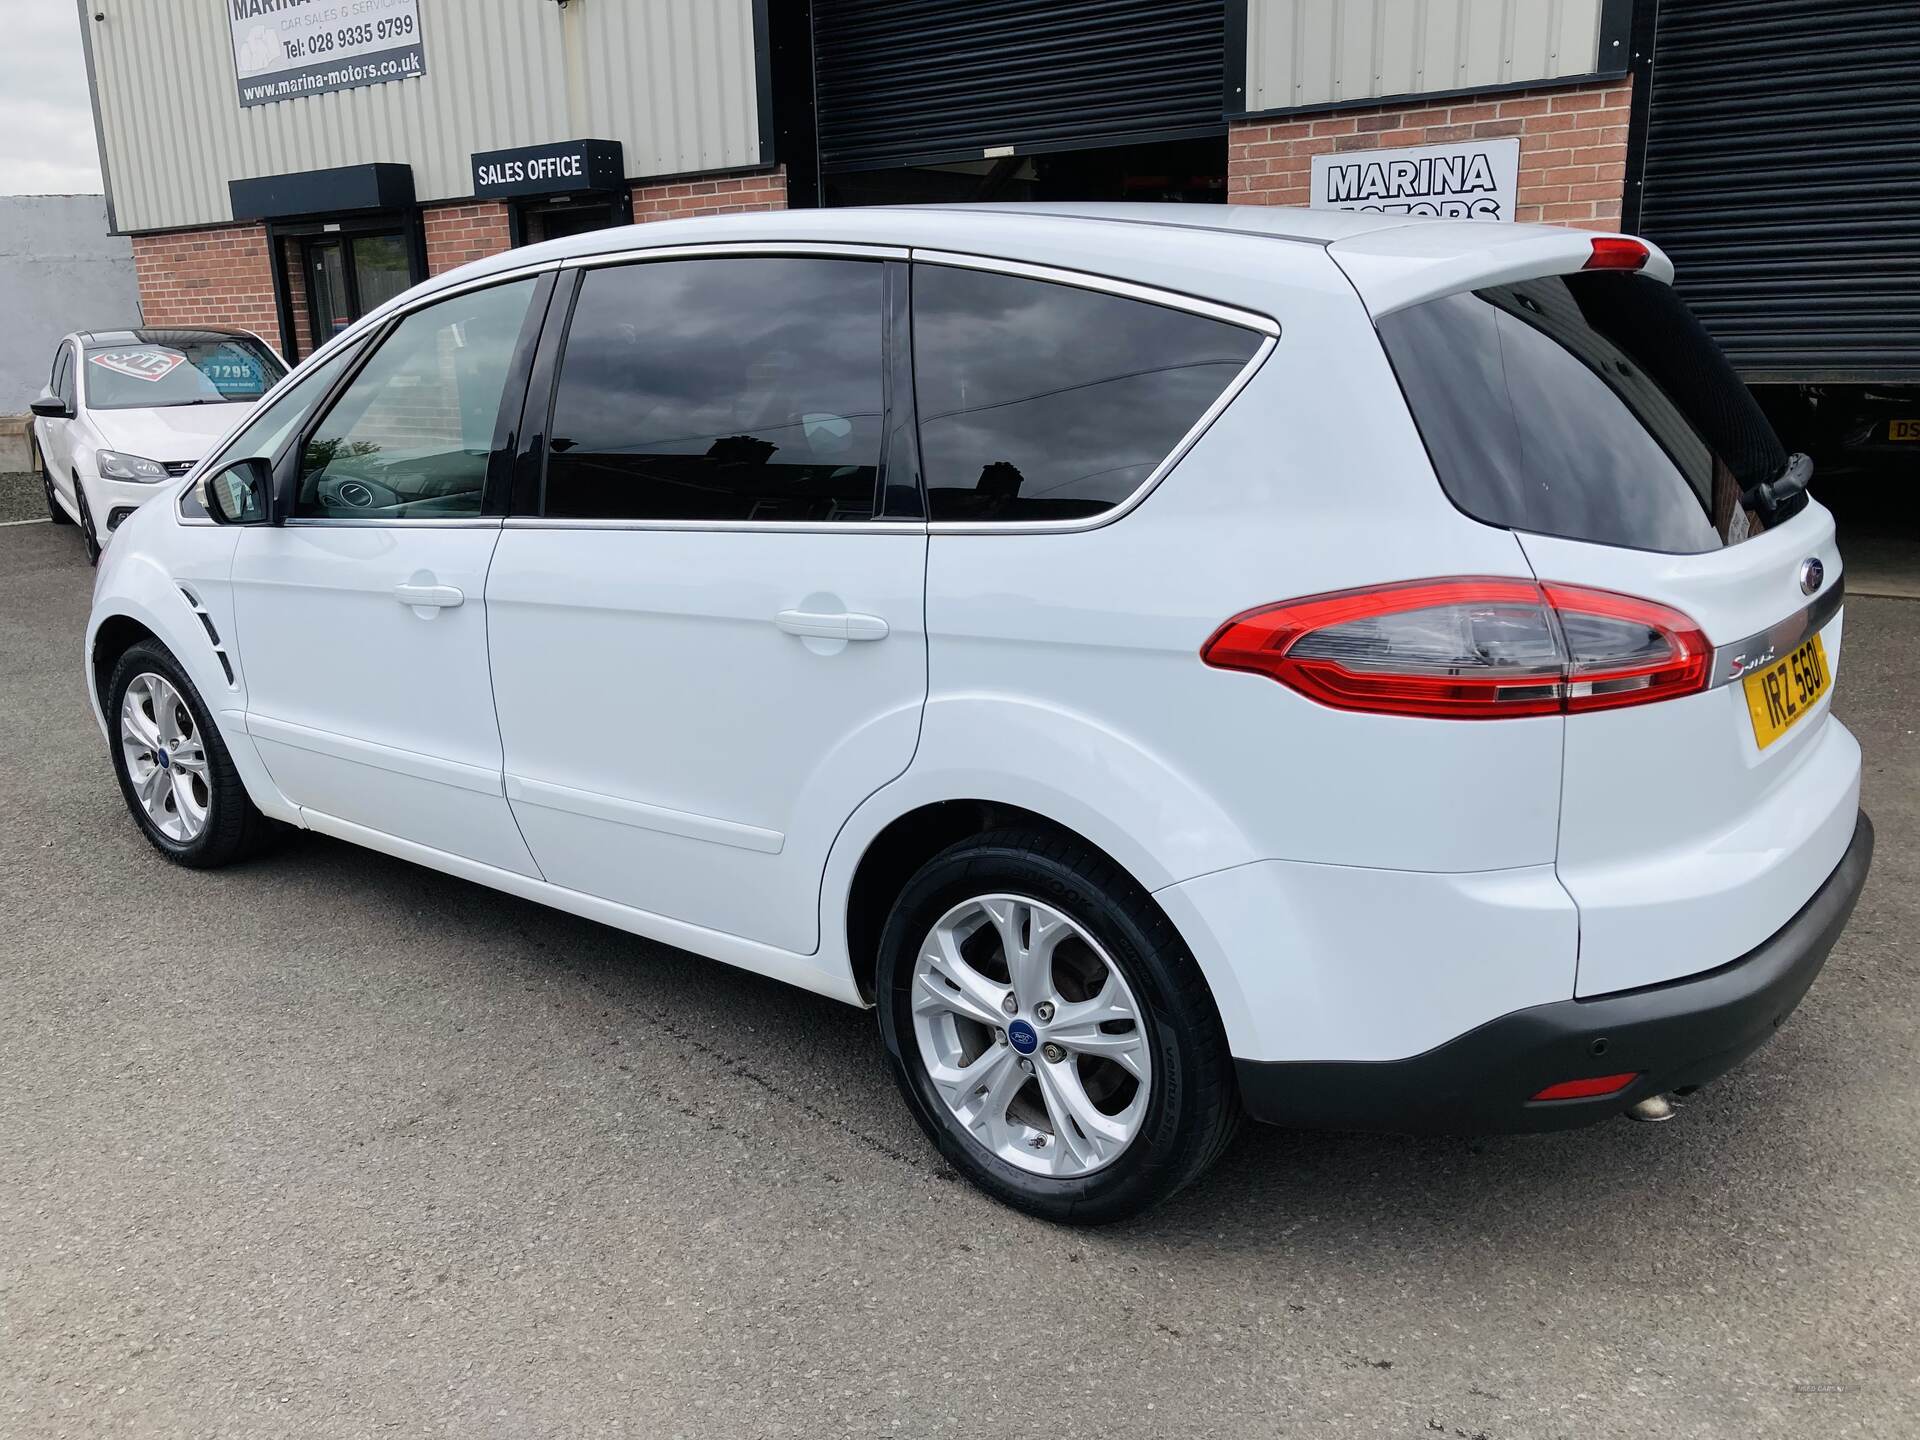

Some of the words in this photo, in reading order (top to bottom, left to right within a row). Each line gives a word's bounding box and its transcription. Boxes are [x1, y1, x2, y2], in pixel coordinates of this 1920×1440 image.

[280, 17, 302, 31] CAR
[304, 8, 338, 26] SALES
[341, 6, 349, 17] &
[283, 40, 305, 59] Tel:
[308, 31, 334, 54] 028
[337, 23, 373, 50] 9335
[377, 14, 413, 41] 9799
[243, 52, 420, 100] www.marina-motors.co.uk
[478, 161, 524, 186] SALES
[527, 155, 582, 180] OFFICE
[1327, 153, 1497, 203] MARINA
[1761, 662, 1796, 729] IRZ
